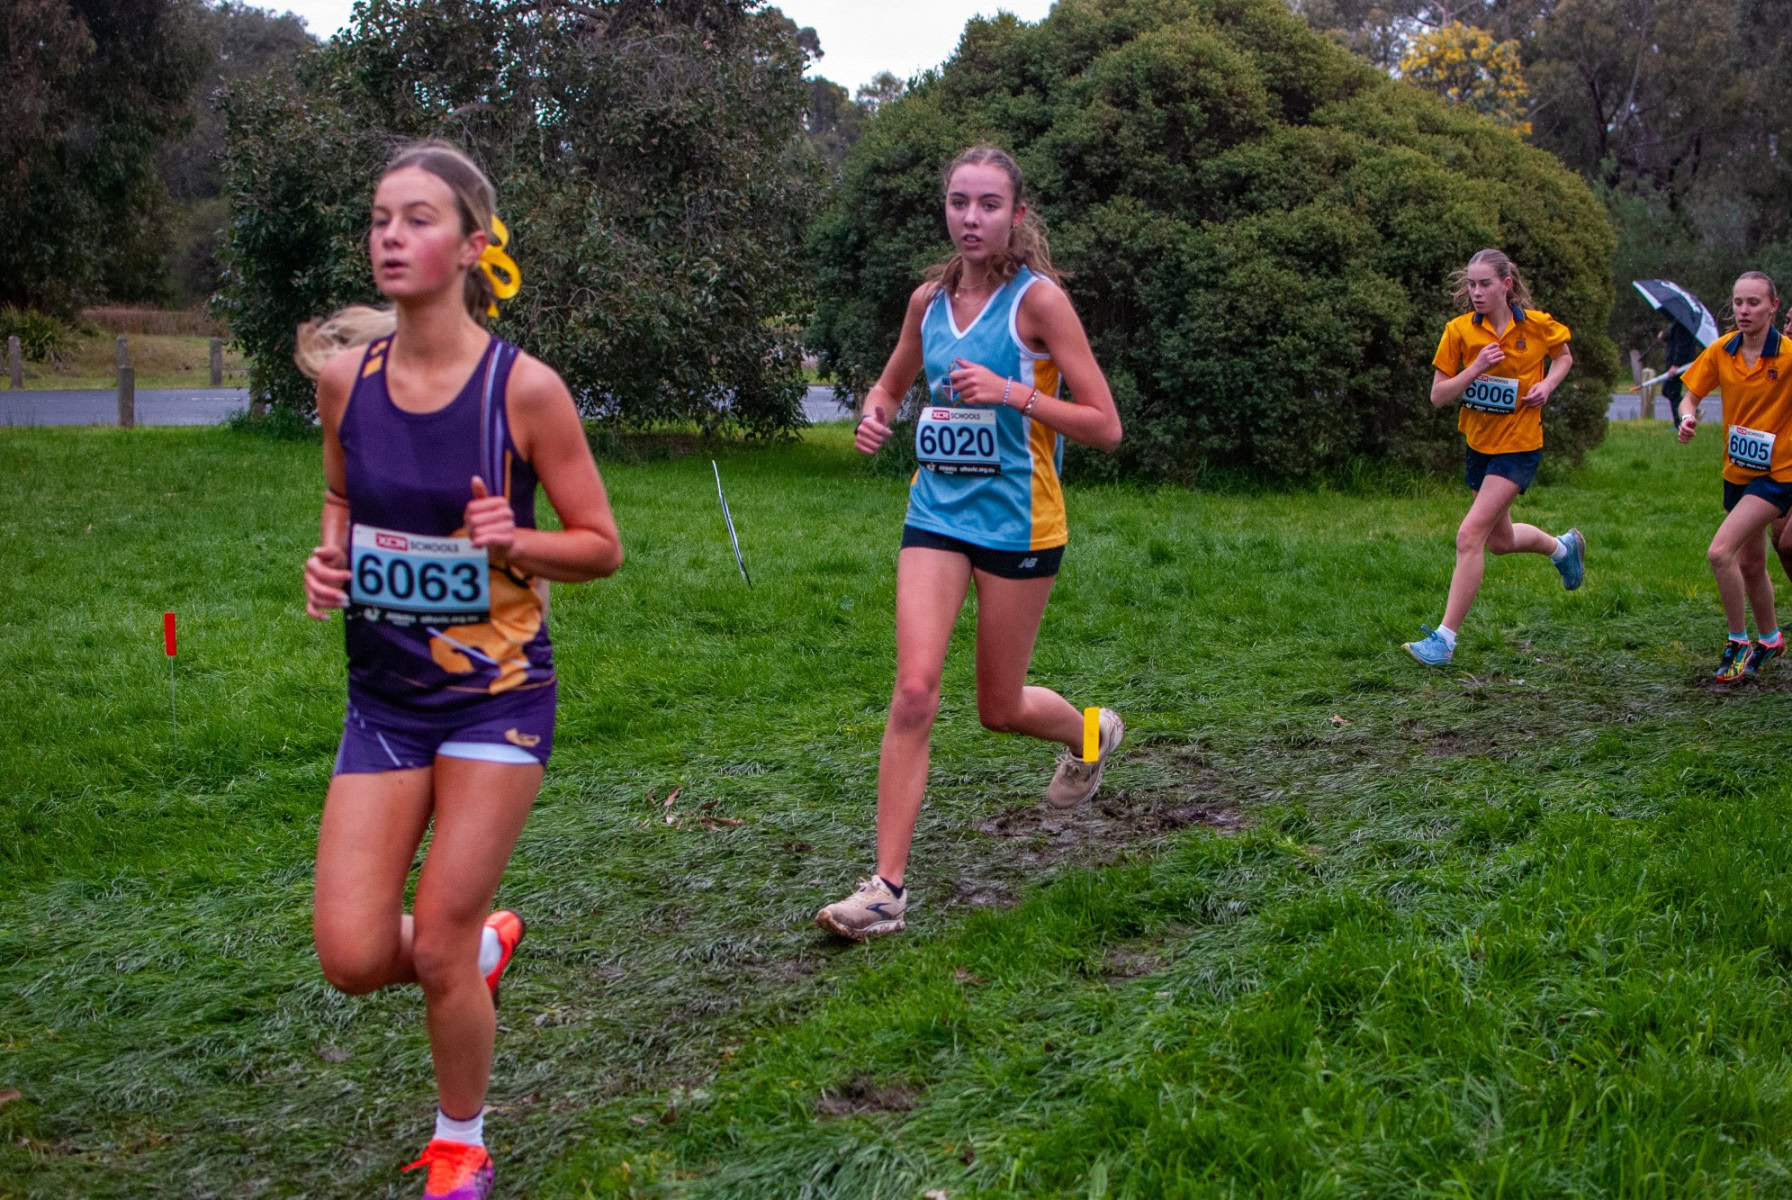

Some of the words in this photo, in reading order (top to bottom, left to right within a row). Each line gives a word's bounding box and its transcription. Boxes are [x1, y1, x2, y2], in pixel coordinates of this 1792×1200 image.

[1466, 382, 1515, 405] 6006
[951, 412, 981, 420] SCHOOLS
[920, 425, 994, 457] 6020
[1730, 435, 1770, 461] 6005
[410, 540, 459, 553] SCHOOLS
[358, 554, 482, 602] 6063
